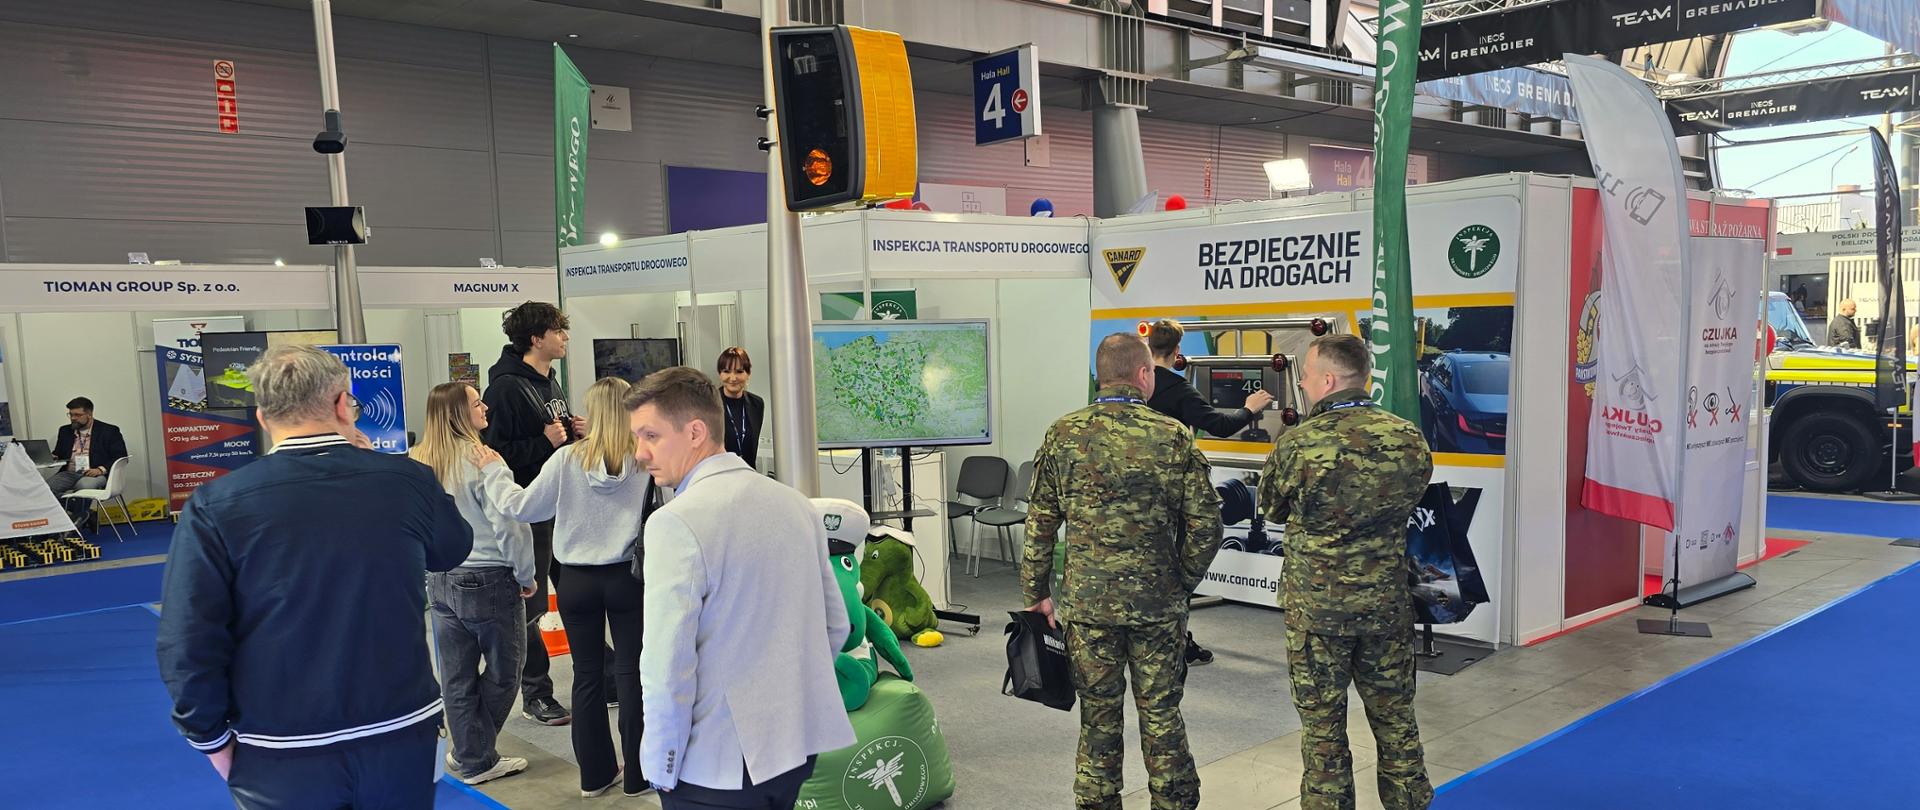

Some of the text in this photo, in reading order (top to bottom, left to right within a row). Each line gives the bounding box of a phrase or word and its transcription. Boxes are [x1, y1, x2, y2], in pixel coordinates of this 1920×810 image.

[1612, 5, 1672, 27] TEAM
[1479, 32, 1505, 44] INEOS
[1451, 37, 1534, 60] GRENADIER
[981, 65, 1010, 80] Hala Hall
[1484, 75, 1511, 95] INEOS
[1860, 86, 1909, 100] TEAM
[983, 82, 1006, 129] 4
[1750, 100, 1773, 109] INEOS
[1678, 104, 1797, 122] TEAM GRENADIER
[1334, 159, 1352, 173] Hala
[1337, 174, 1352, 186] Hall
[1728, 221, 1762, 238] POŻARNA
[873, 239, 1089, 254] INSPEKCJA TRANSPORTU DROGOWEGO
[1199, 230, 1361, 267] BEZPIECZNIE
[1106, 250, 1141, 262] CANARD
[566, 256, 688, 277] INSPEKCJA TRANSPORTU DROGOWEGO
[1204, 260, 1352, 290] NA DROGACH
[43, 281, 239, 294] TIOMAN GROUP Sp. z o.o.
[454, 283, 519, 292] MAGNUM X
[1702, 327, 1737, 340] CZUJKA
[180, 353, 203, 363] SYST
[327, 348, 387, 362] ontrola
[1241, 380, 1262, 394] 49
[167, 424, 220, 433] KOMPAKTOWY
[223, 440, 250, 448] MOCNY
[172, 470, 216, 480] BEZPIECZNY
[848, 739, 902, 779] INSPEKCJ
